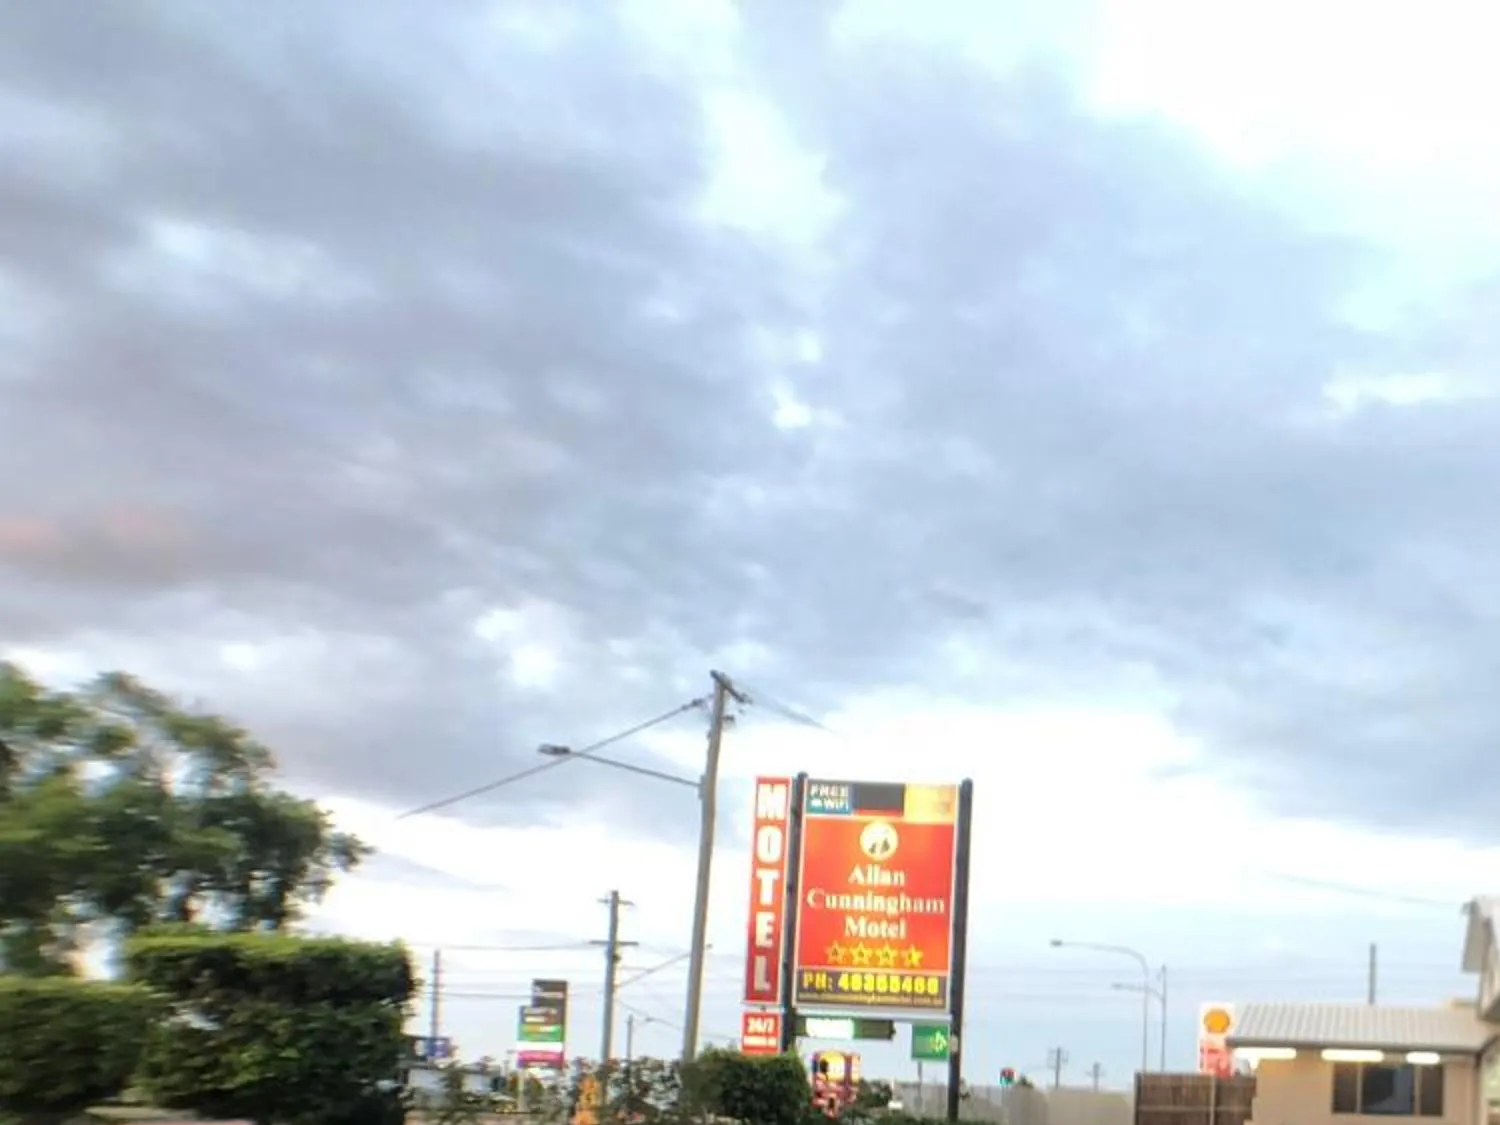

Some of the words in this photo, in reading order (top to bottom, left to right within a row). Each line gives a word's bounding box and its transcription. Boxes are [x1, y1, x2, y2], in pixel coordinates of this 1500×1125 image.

[754, 783, 787, 991] MOTEL
[848, 863, 905, 887] Allan
[806, 887, 945, 916] Cunningham
[844, 915, 907, 939] Motel
